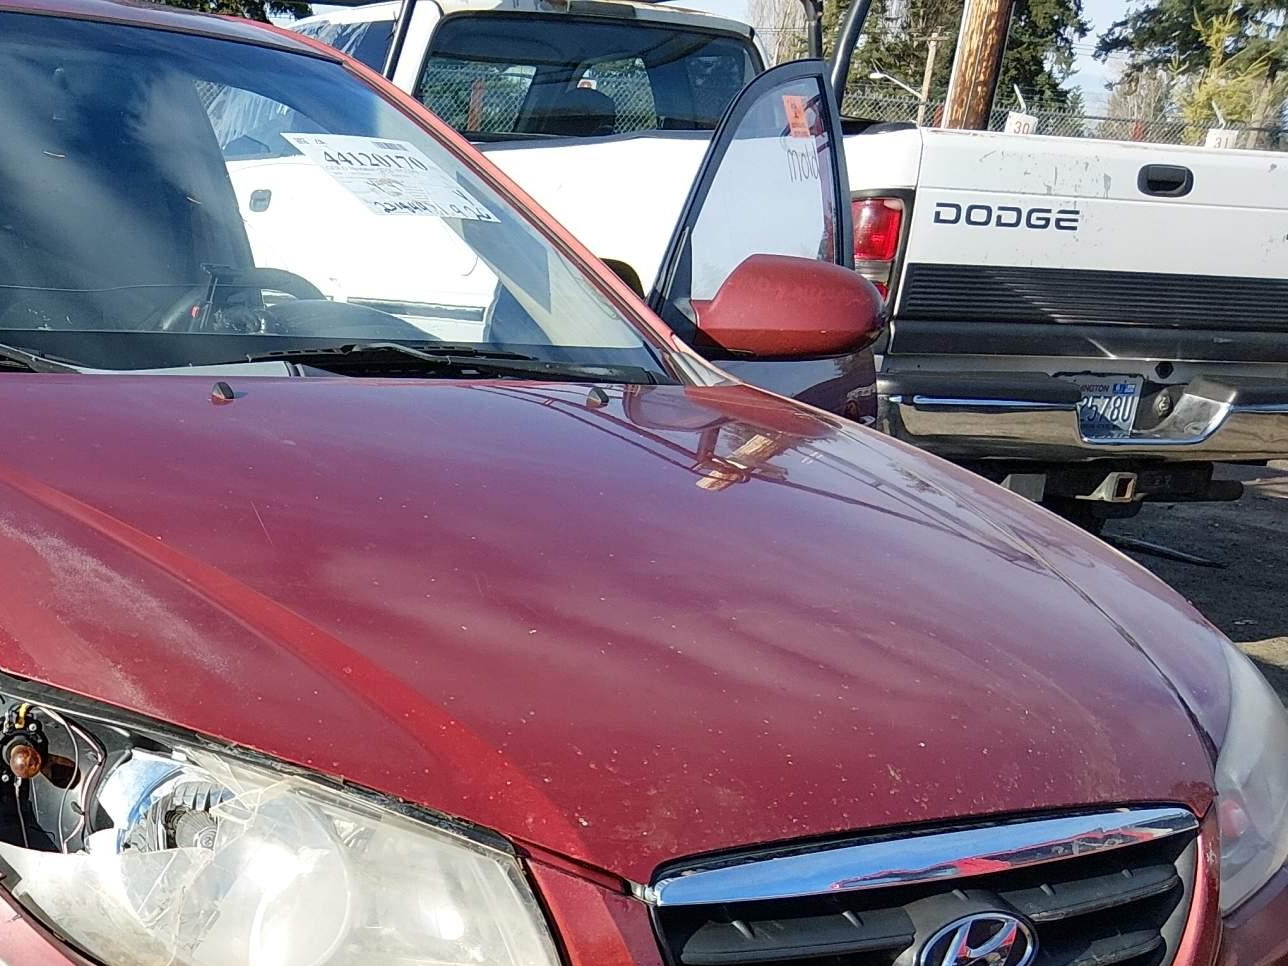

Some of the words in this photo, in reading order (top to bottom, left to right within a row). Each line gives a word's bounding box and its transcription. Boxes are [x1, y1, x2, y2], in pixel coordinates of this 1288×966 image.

[1013, 120, 1030, 135] 30
[1214, 136, 1228, 149] 31
[324, 151, 429, 171] 44120170
[933, 202, 1081, 231] DODGE
[1079, 384, 1110, 393] INGTON
[1079, 395, 1136, 422] 2578U
